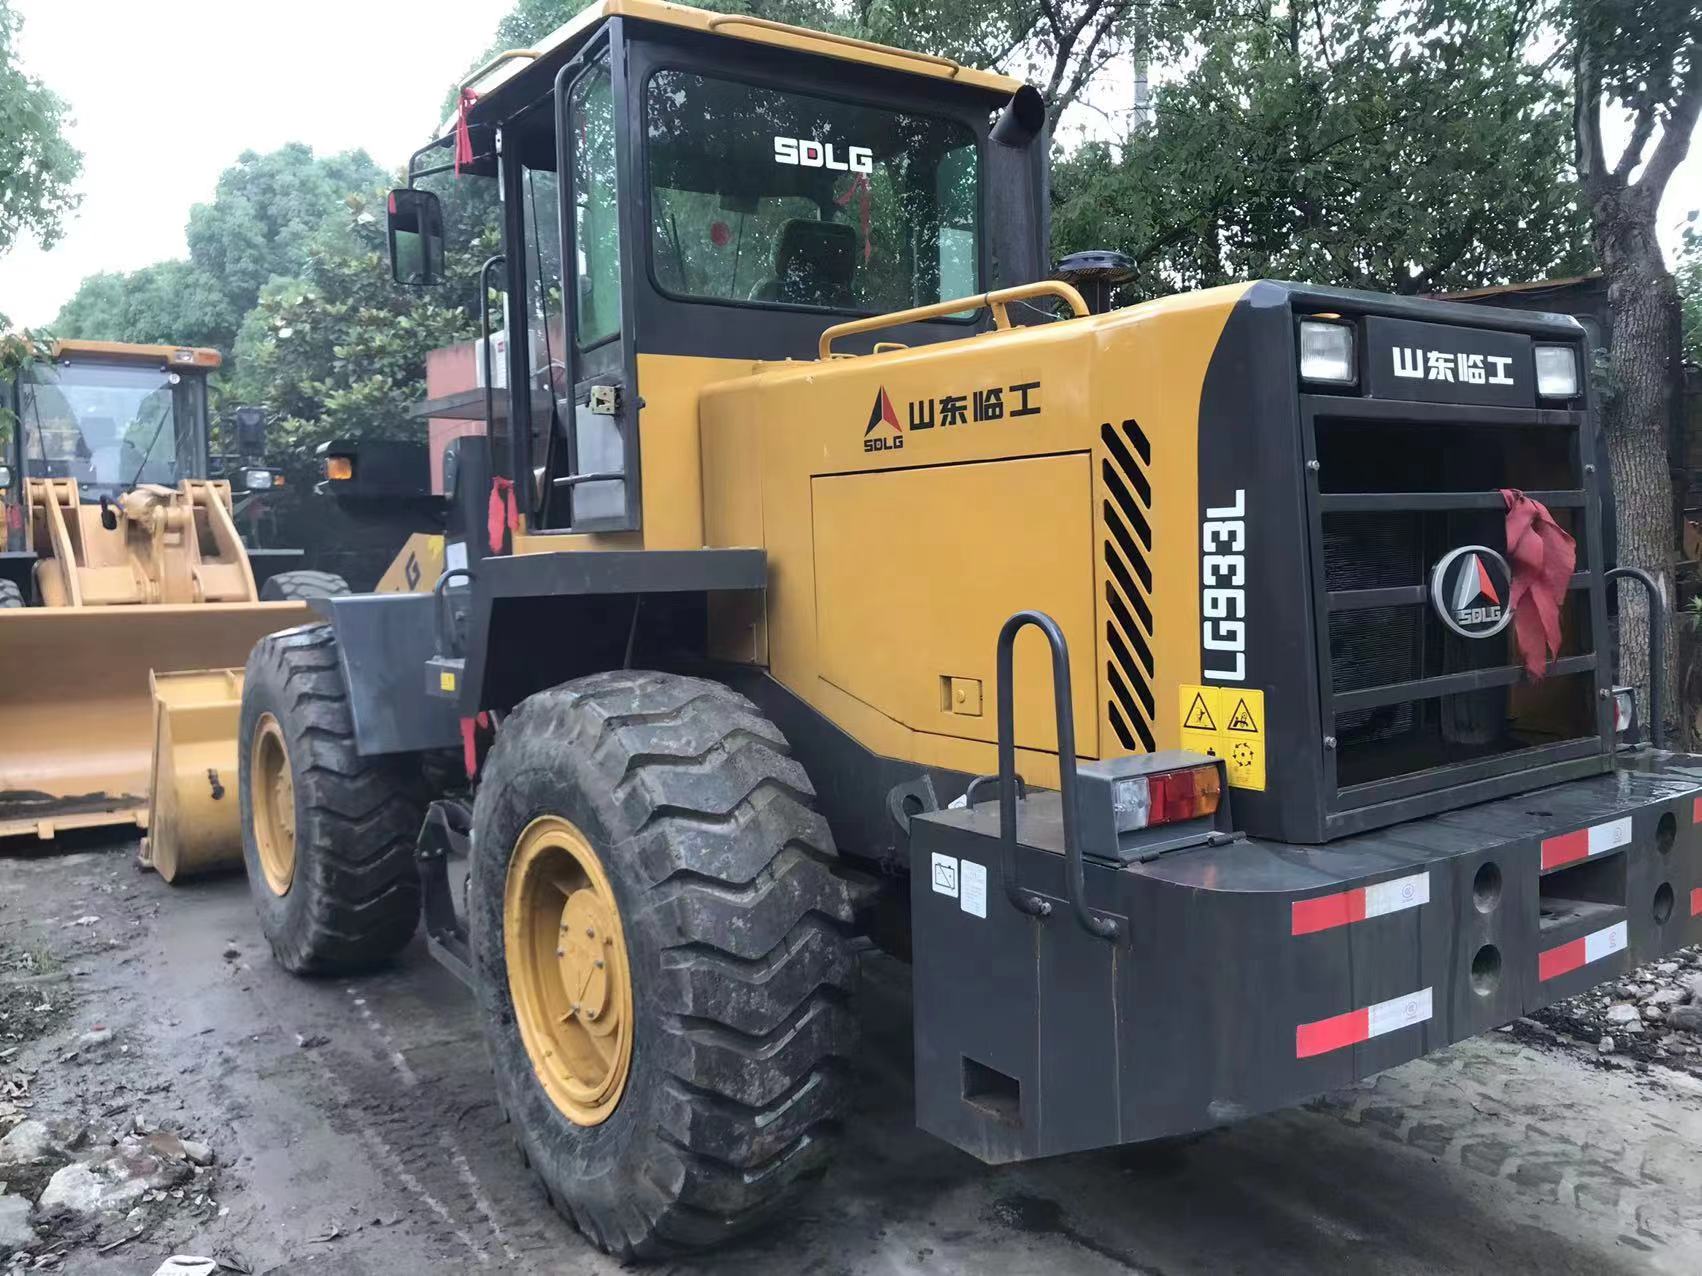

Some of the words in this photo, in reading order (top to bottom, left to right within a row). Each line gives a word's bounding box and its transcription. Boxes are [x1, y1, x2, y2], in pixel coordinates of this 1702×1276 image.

[774, 136, 873, 174] SDLG
[1392, 346, 1514, 385] 山东临工
[909, 381, 1041, 431] 山东临工
[864, 435, 904, 453] SDLG
[1203, 489, 1246, 681] LG933L
[1457, 605, 1501, 626] SDLG
